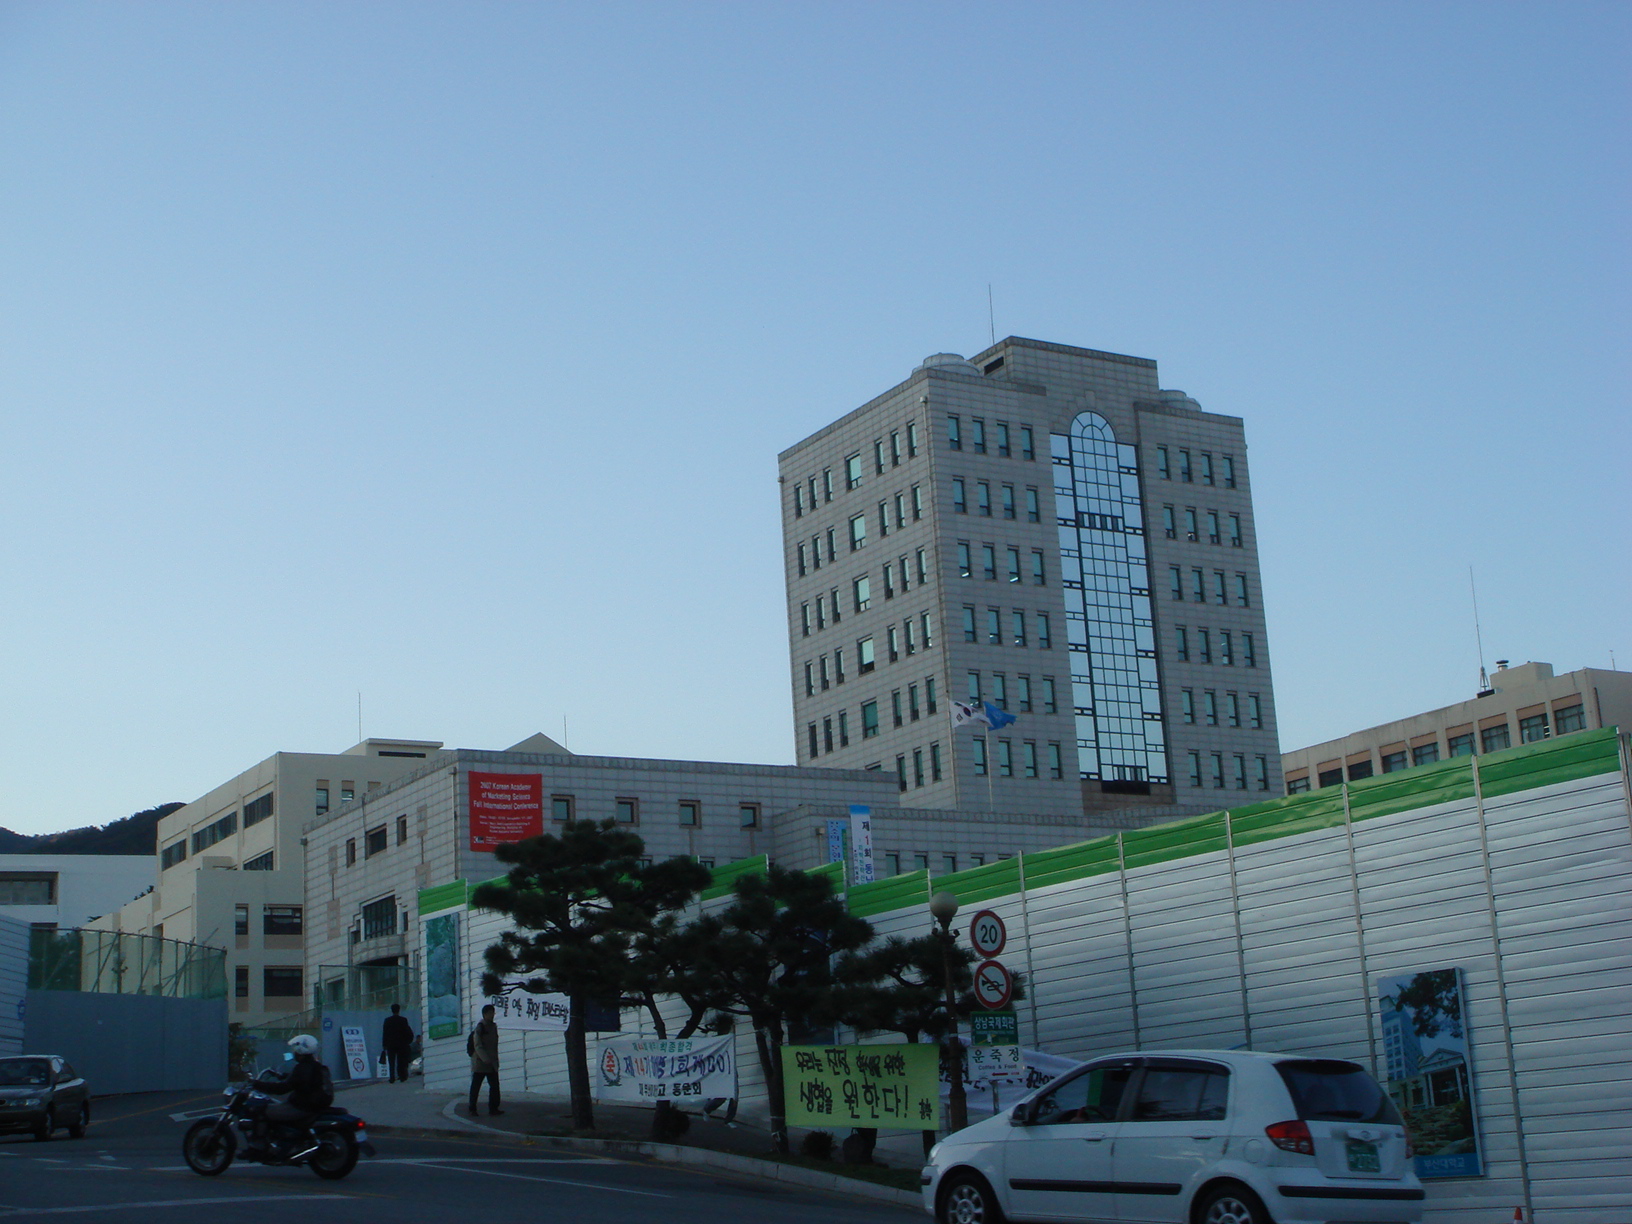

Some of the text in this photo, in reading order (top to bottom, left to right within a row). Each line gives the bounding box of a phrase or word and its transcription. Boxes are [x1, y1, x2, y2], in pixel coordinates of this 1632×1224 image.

[480, 781, 492, 789] 2007
[481, 791, 487, 799] of
[487, 792, 511, 801] Marketing
[473, 800, 539, 810] Fall International Conference
[980, 924, 998, 944] 20
[795, 1048, 906, 1077] 우리는 진정 학생을 위한
[842, 1072, 909, 1118] 원한다!
